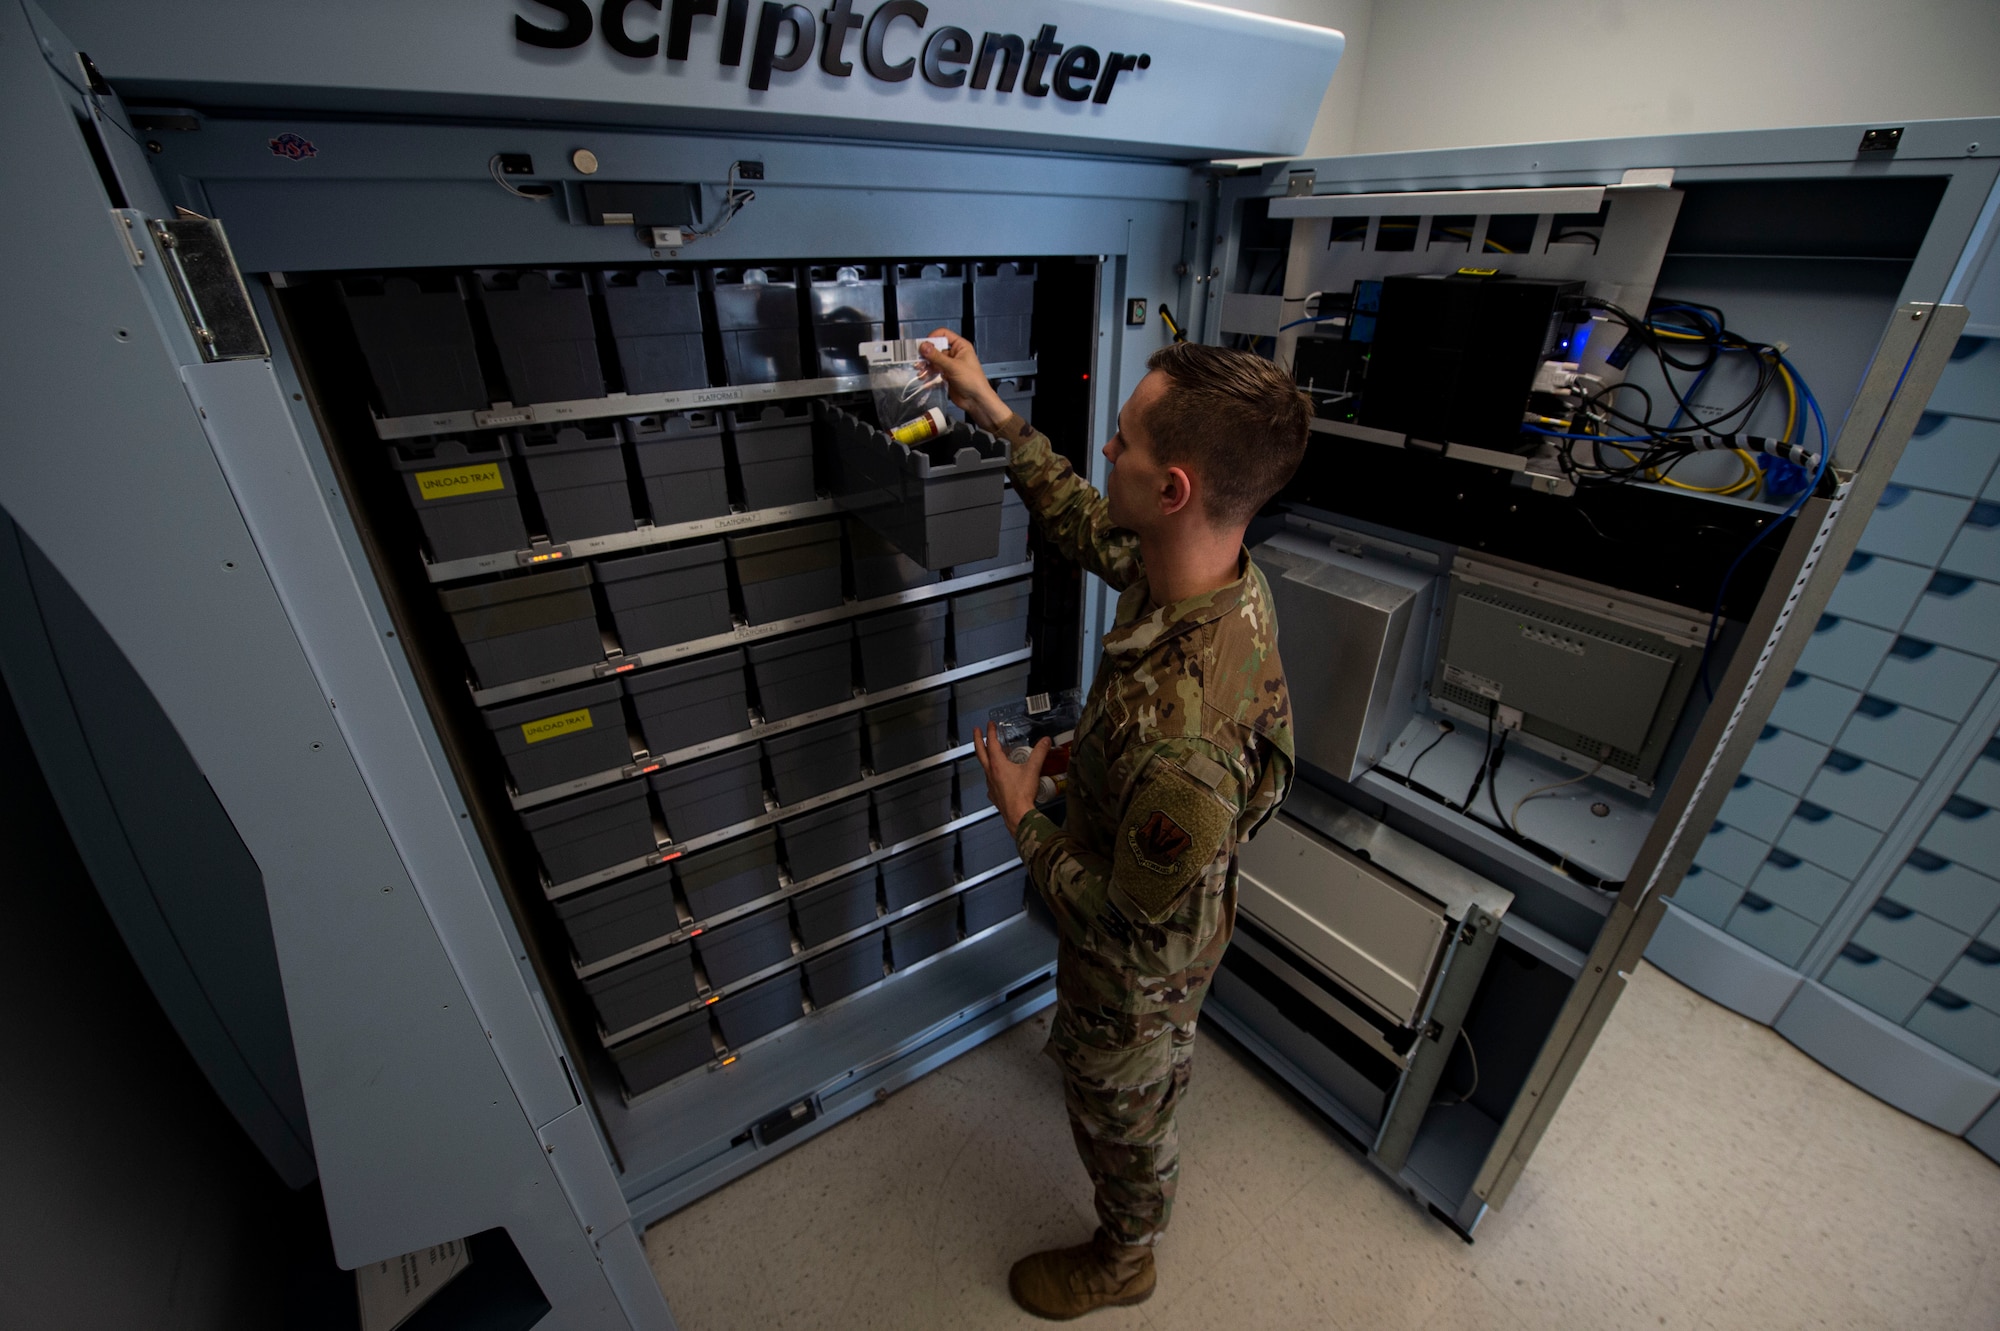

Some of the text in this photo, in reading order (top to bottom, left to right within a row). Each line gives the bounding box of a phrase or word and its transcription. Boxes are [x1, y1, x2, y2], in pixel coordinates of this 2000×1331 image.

[698, 393, 733, 402] PLATFORM
[422, 471, 497, 490] UNLOAD TRAY
[719, 517, 752, 527] PLATFORM
[526, 714, 586, 736] UNLOAD TRAY
